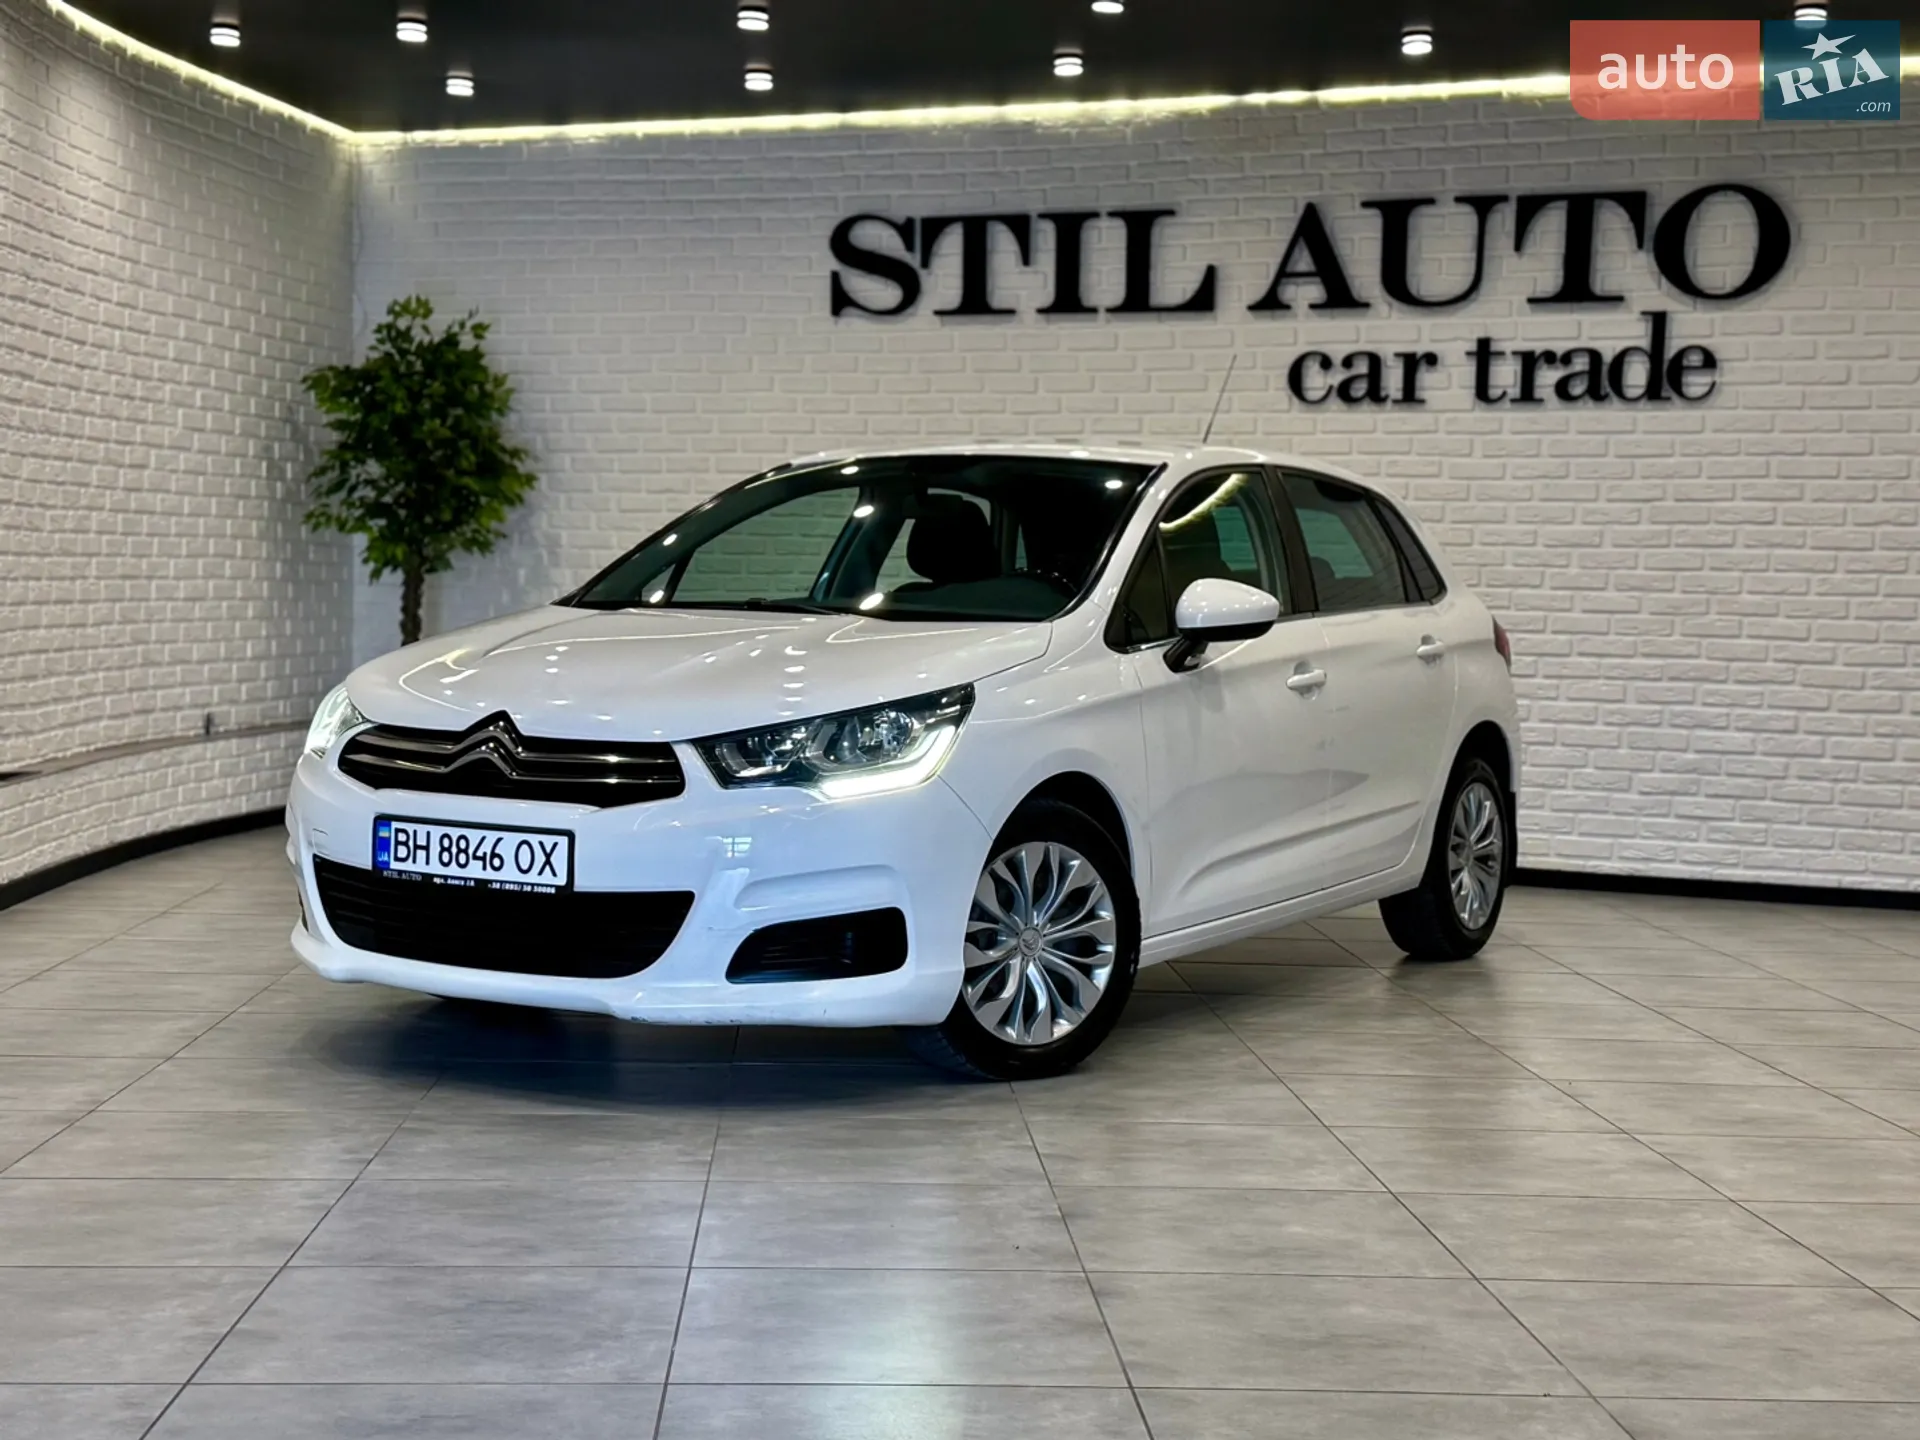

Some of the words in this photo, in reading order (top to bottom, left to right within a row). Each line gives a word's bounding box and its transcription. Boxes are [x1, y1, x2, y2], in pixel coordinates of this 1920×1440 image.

[829, 208, 1217, 317] STIL
[1246, 183, 1792, 312] AUTO
[1287, 348, 1439, 406] car
[1466, 310, 1720, 406] trade
[377, 851, 389, 862] UA
[393, 827, 431, 866] BH
[438, 833, 505, 872] 8846
[514, 839, 560, 878] OX
[401, 871, 422, 882] AUTO
